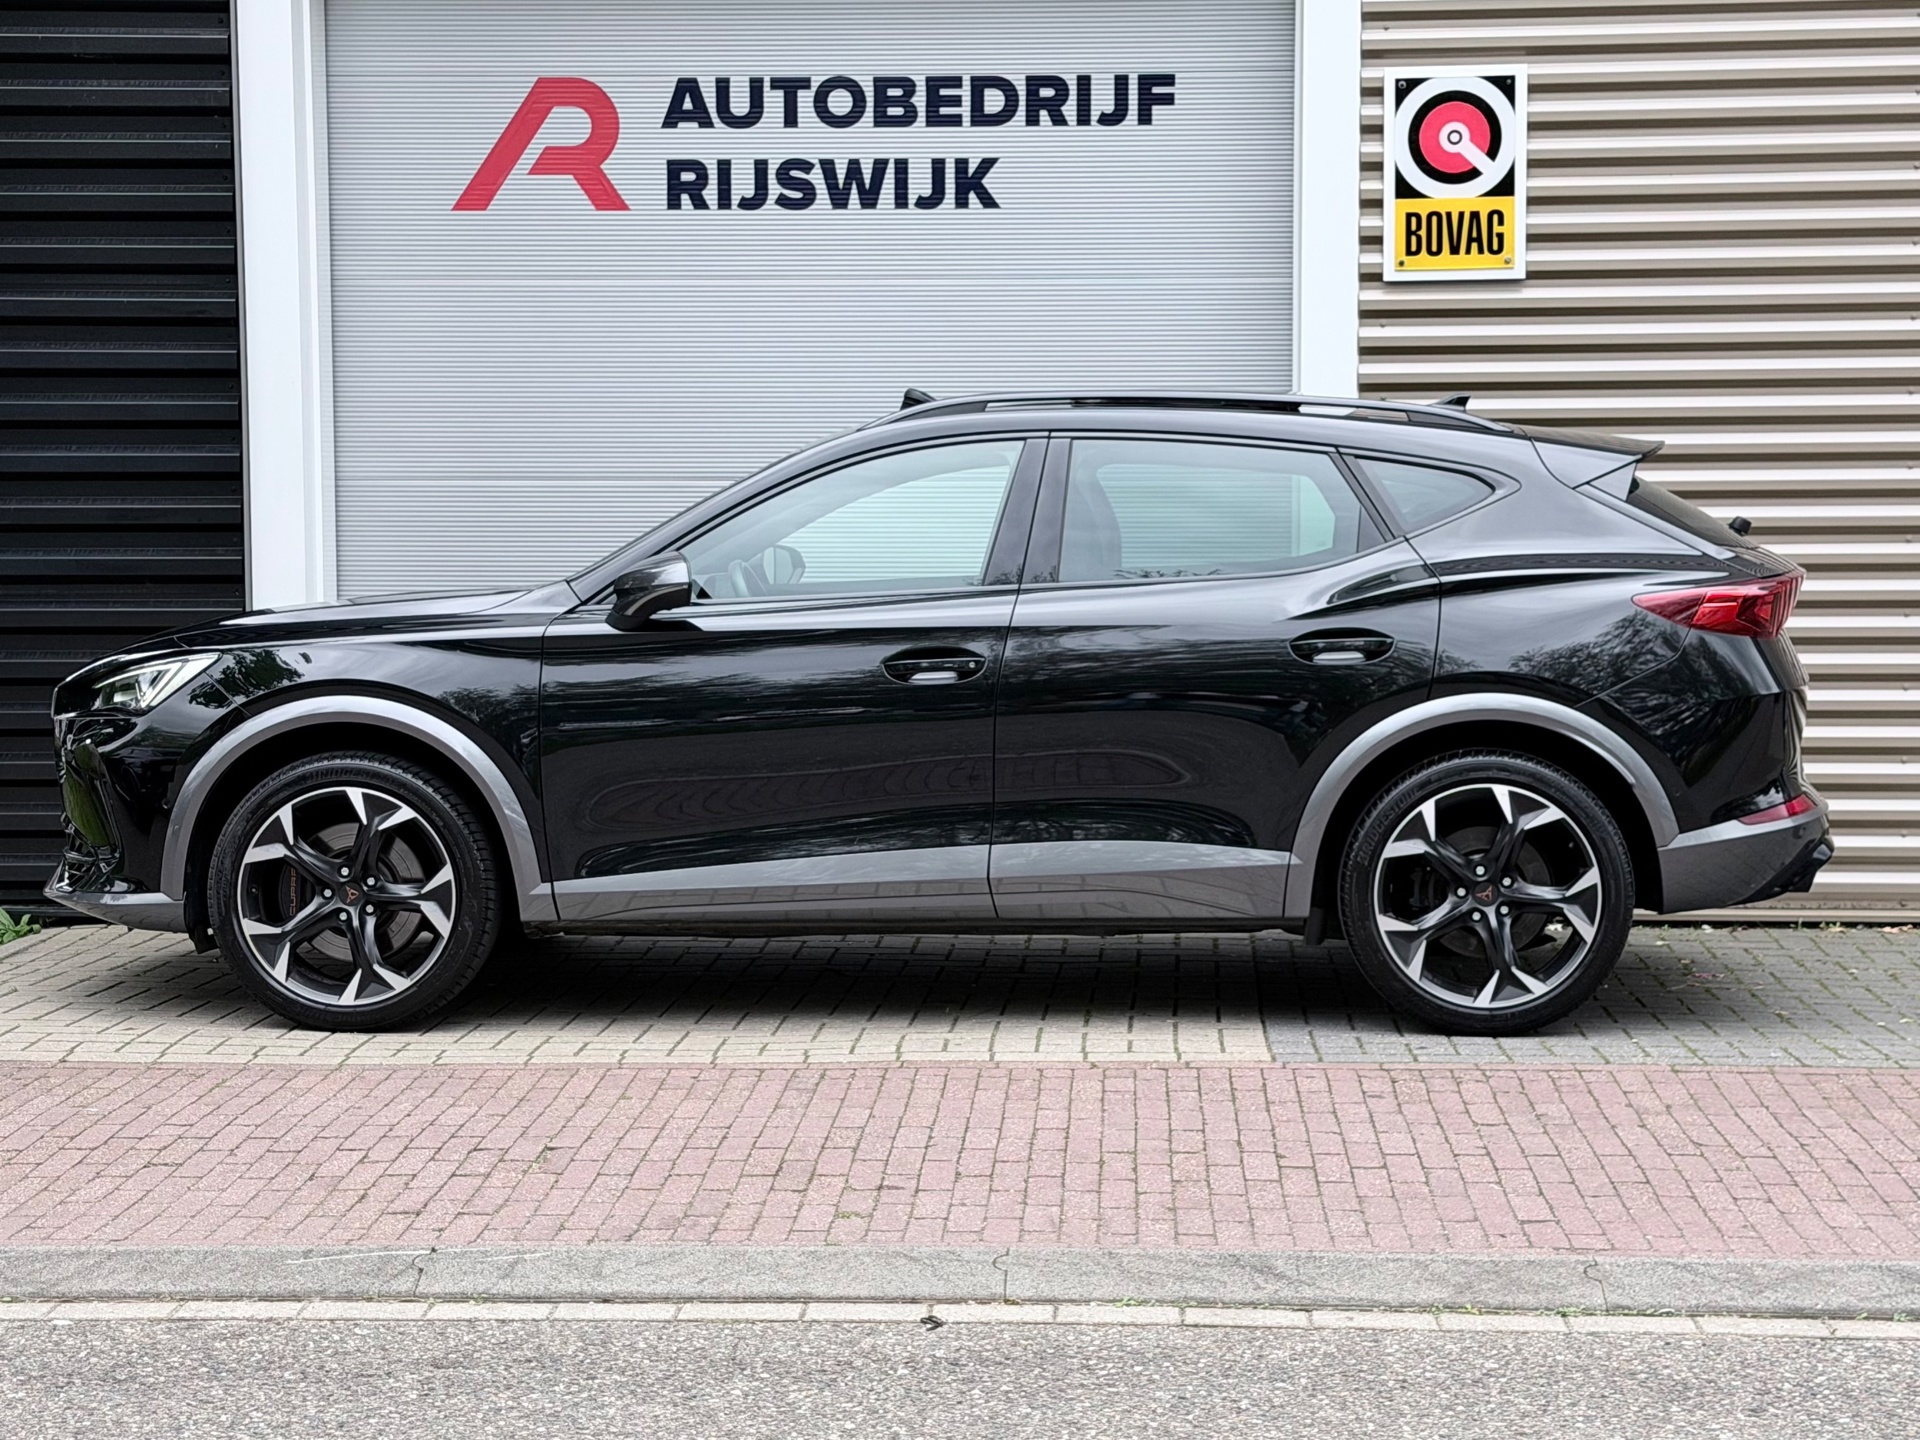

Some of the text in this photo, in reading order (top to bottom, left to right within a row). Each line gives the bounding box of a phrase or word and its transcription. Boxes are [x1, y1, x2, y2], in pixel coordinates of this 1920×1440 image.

[661, 74, 1176, 129] AUTOBEDRIJF
[667, 157, 1001, 211] RIJSWIJK
[1405, 209, 1505, 257] BOVAG
